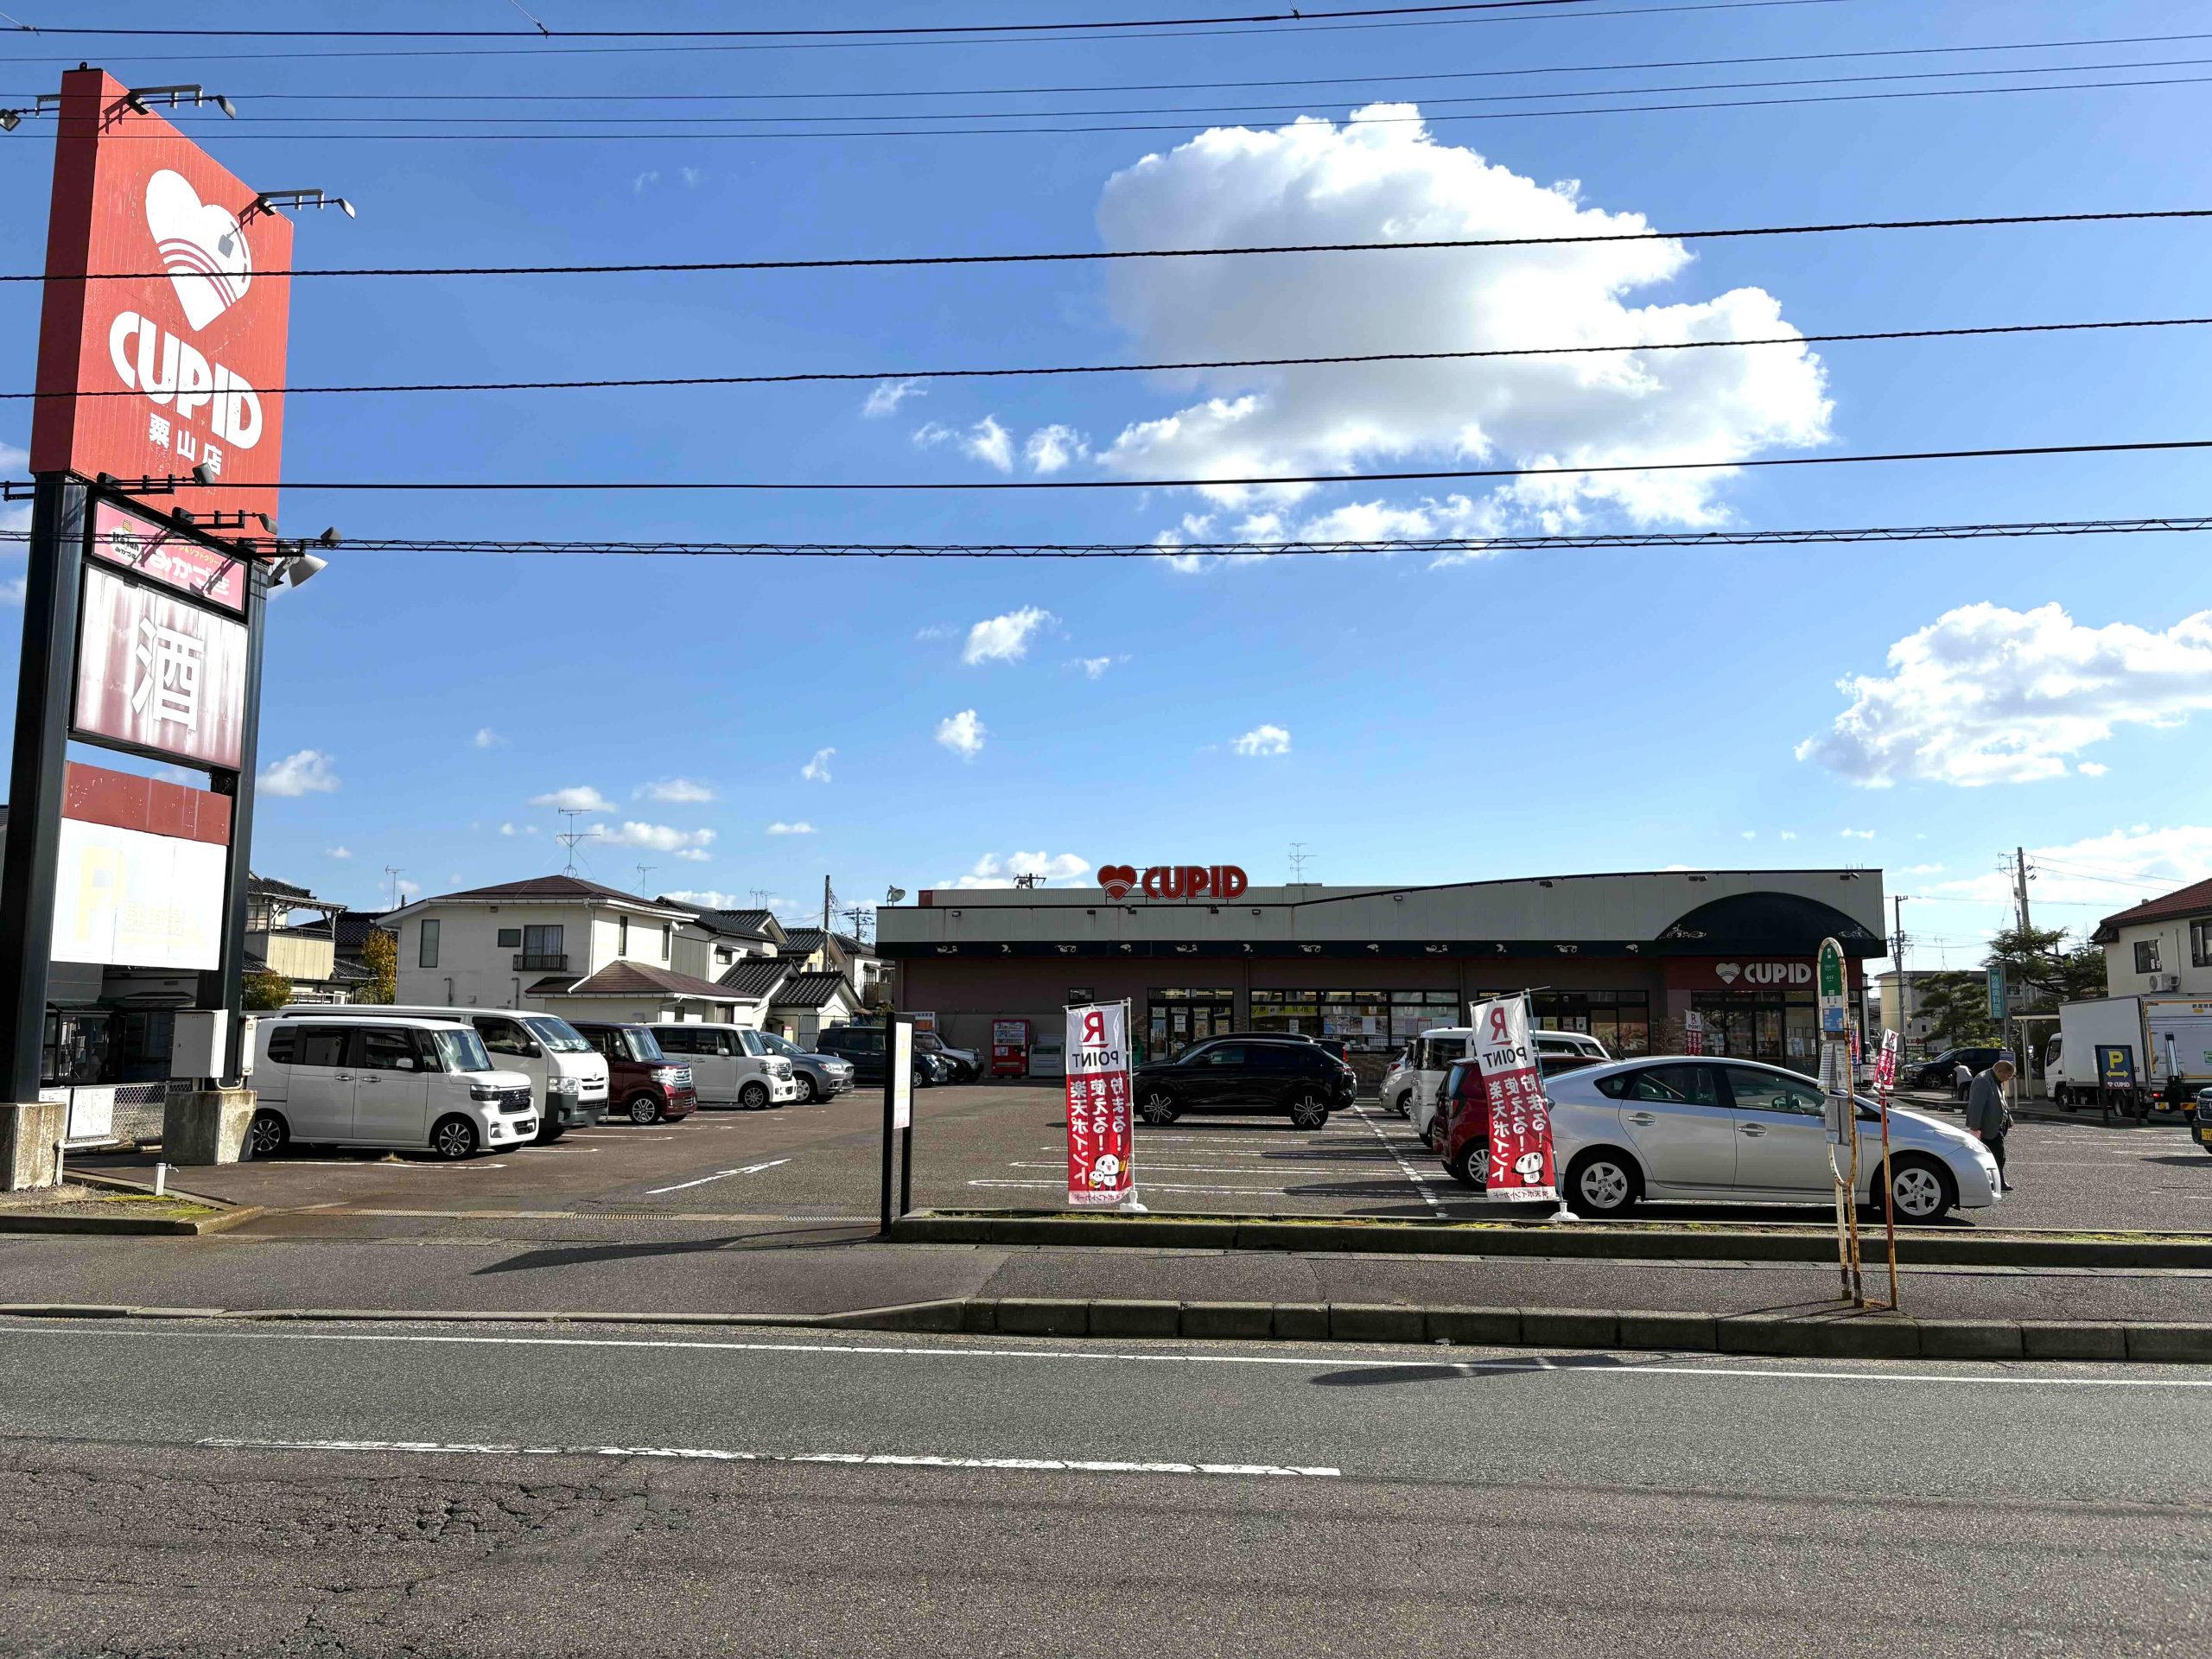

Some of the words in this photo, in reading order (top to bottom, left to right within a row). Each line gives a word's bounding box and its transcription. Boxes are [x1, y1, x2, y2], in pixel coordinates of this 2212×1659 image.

[109, 311, 263, 449] CUPID
[131, 617, 206, 732] 酒
[1141, 865, 1248, 899] CUPID
[1745, 963, 1812, 983] CUPID
[2108, 1051, 2124, 1069] P
